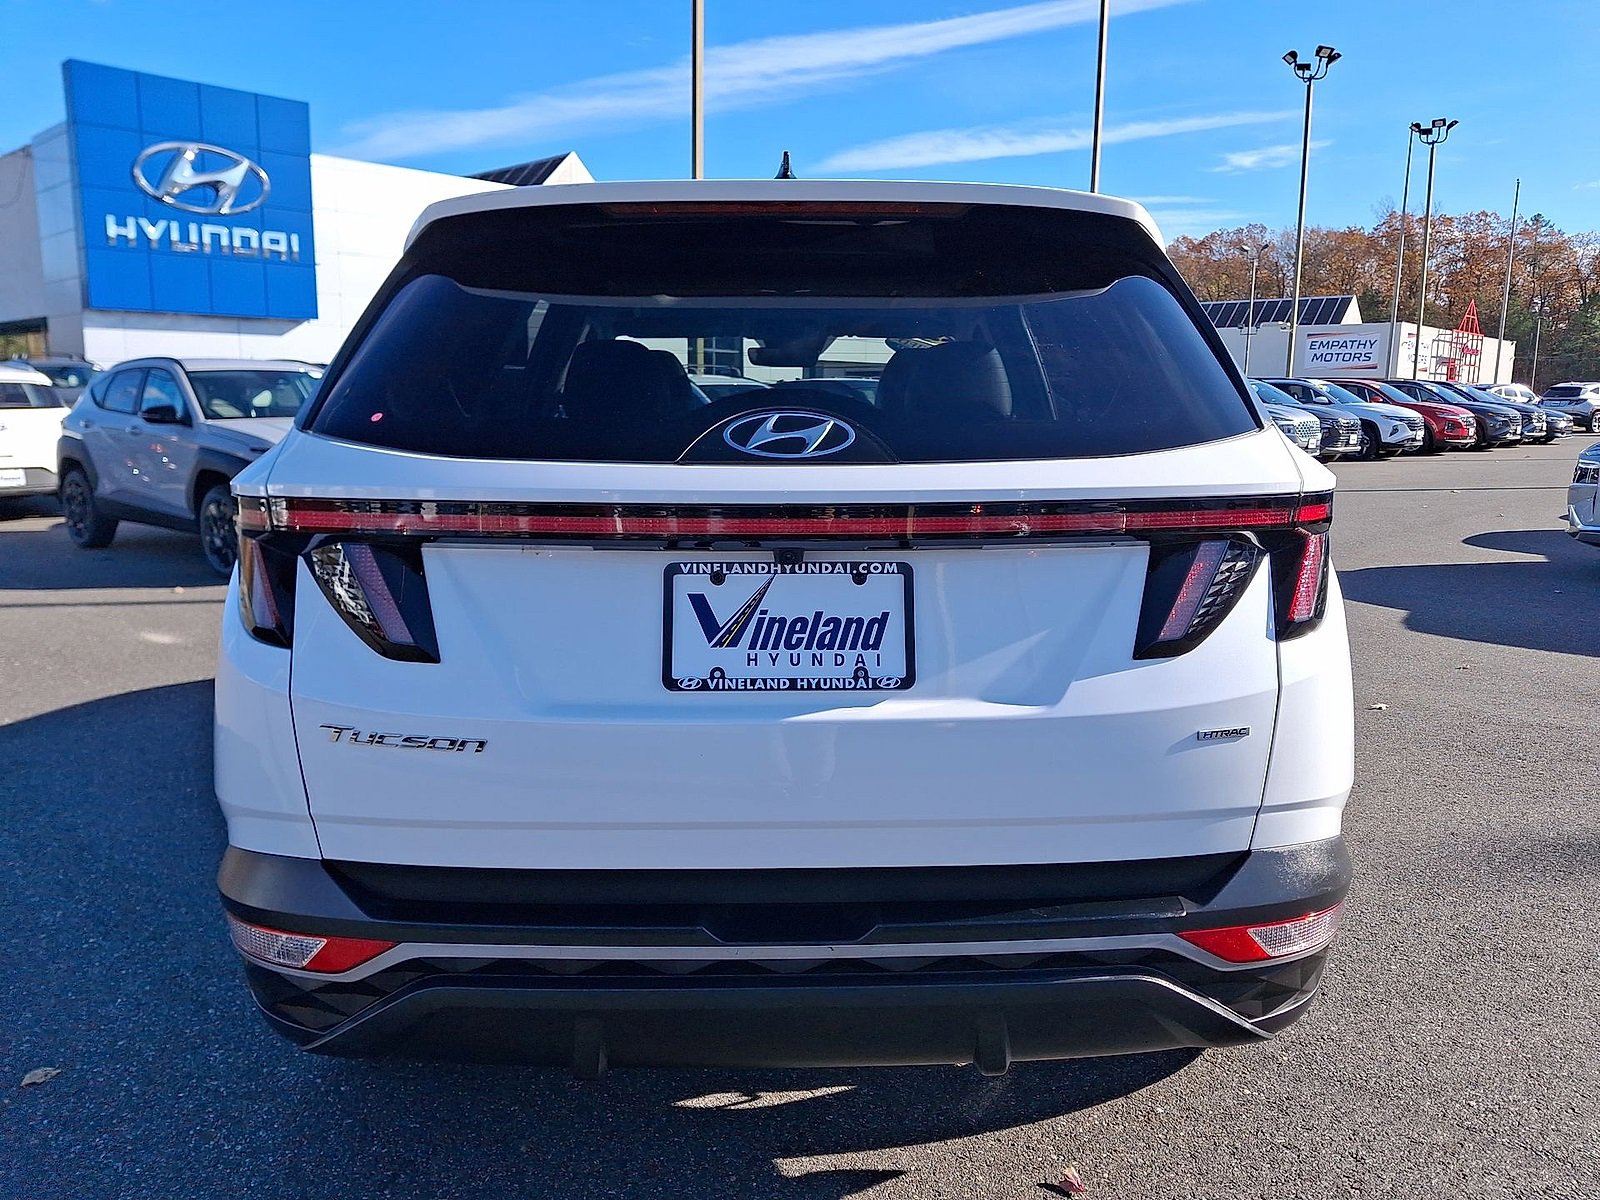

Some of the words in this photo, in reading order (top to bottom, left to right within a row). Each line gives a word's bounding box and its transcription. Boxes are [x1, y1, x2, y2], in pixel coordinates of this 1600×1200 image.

[105, 213, 300, 262] HYUNDAI
[1309, 339, 1378, 351] EMPATHY
[1311, 352, 1373, 363] MOTORS
[679, 562, 899, 574] VINELANDHYUNDAI.COM
[686, 573, 891, 651] Vineland
[746, 652, 882, 667] HYUNDAI
[707, 677, 790, 690] VINELAND
[797, 677, 873, 690] HYUNDAI
[1202, 727, 1247, 739] HTRAC
